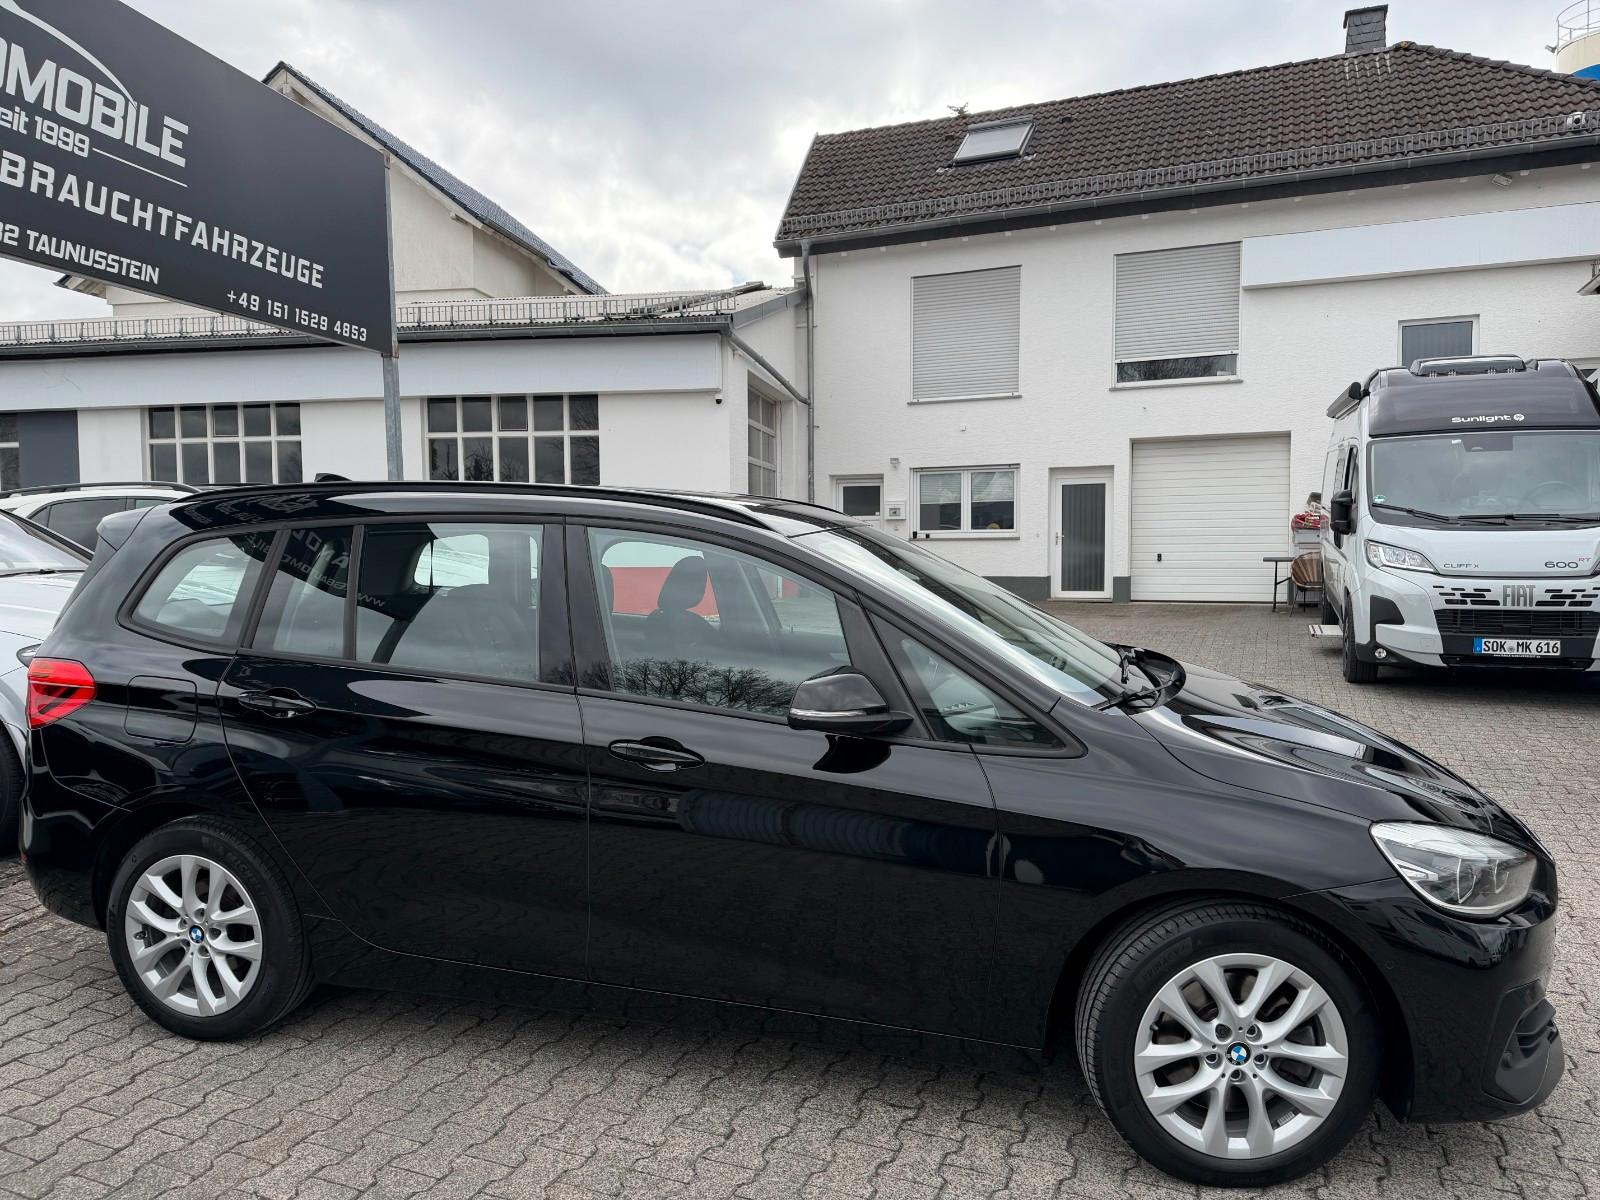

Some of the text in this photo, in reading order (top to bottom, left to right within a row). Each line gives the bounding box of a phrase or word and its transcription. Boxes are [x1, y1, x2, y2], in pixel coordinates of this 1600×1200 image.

[0, 37, 189, 168] MOBILE
[34, 115, 90, 158] 1999
[0, 150, 324, 289] BRAUCHTFAHRZEUGE
[0, 222, 160, 285] 2 TAUNUSSTEIN
[227, 290, 367, 342] +49 151 1529 4853
[1451, 414, 1512, 423] Sunlight
[1544, 561, 1579, 569] 600
[1502, 585, 1536, 607] FIAT
[1483, 640, 1507, 653] SOK
[1516, 641, 1533, 653] MK
[1535, 641, 1559, 654] 616
